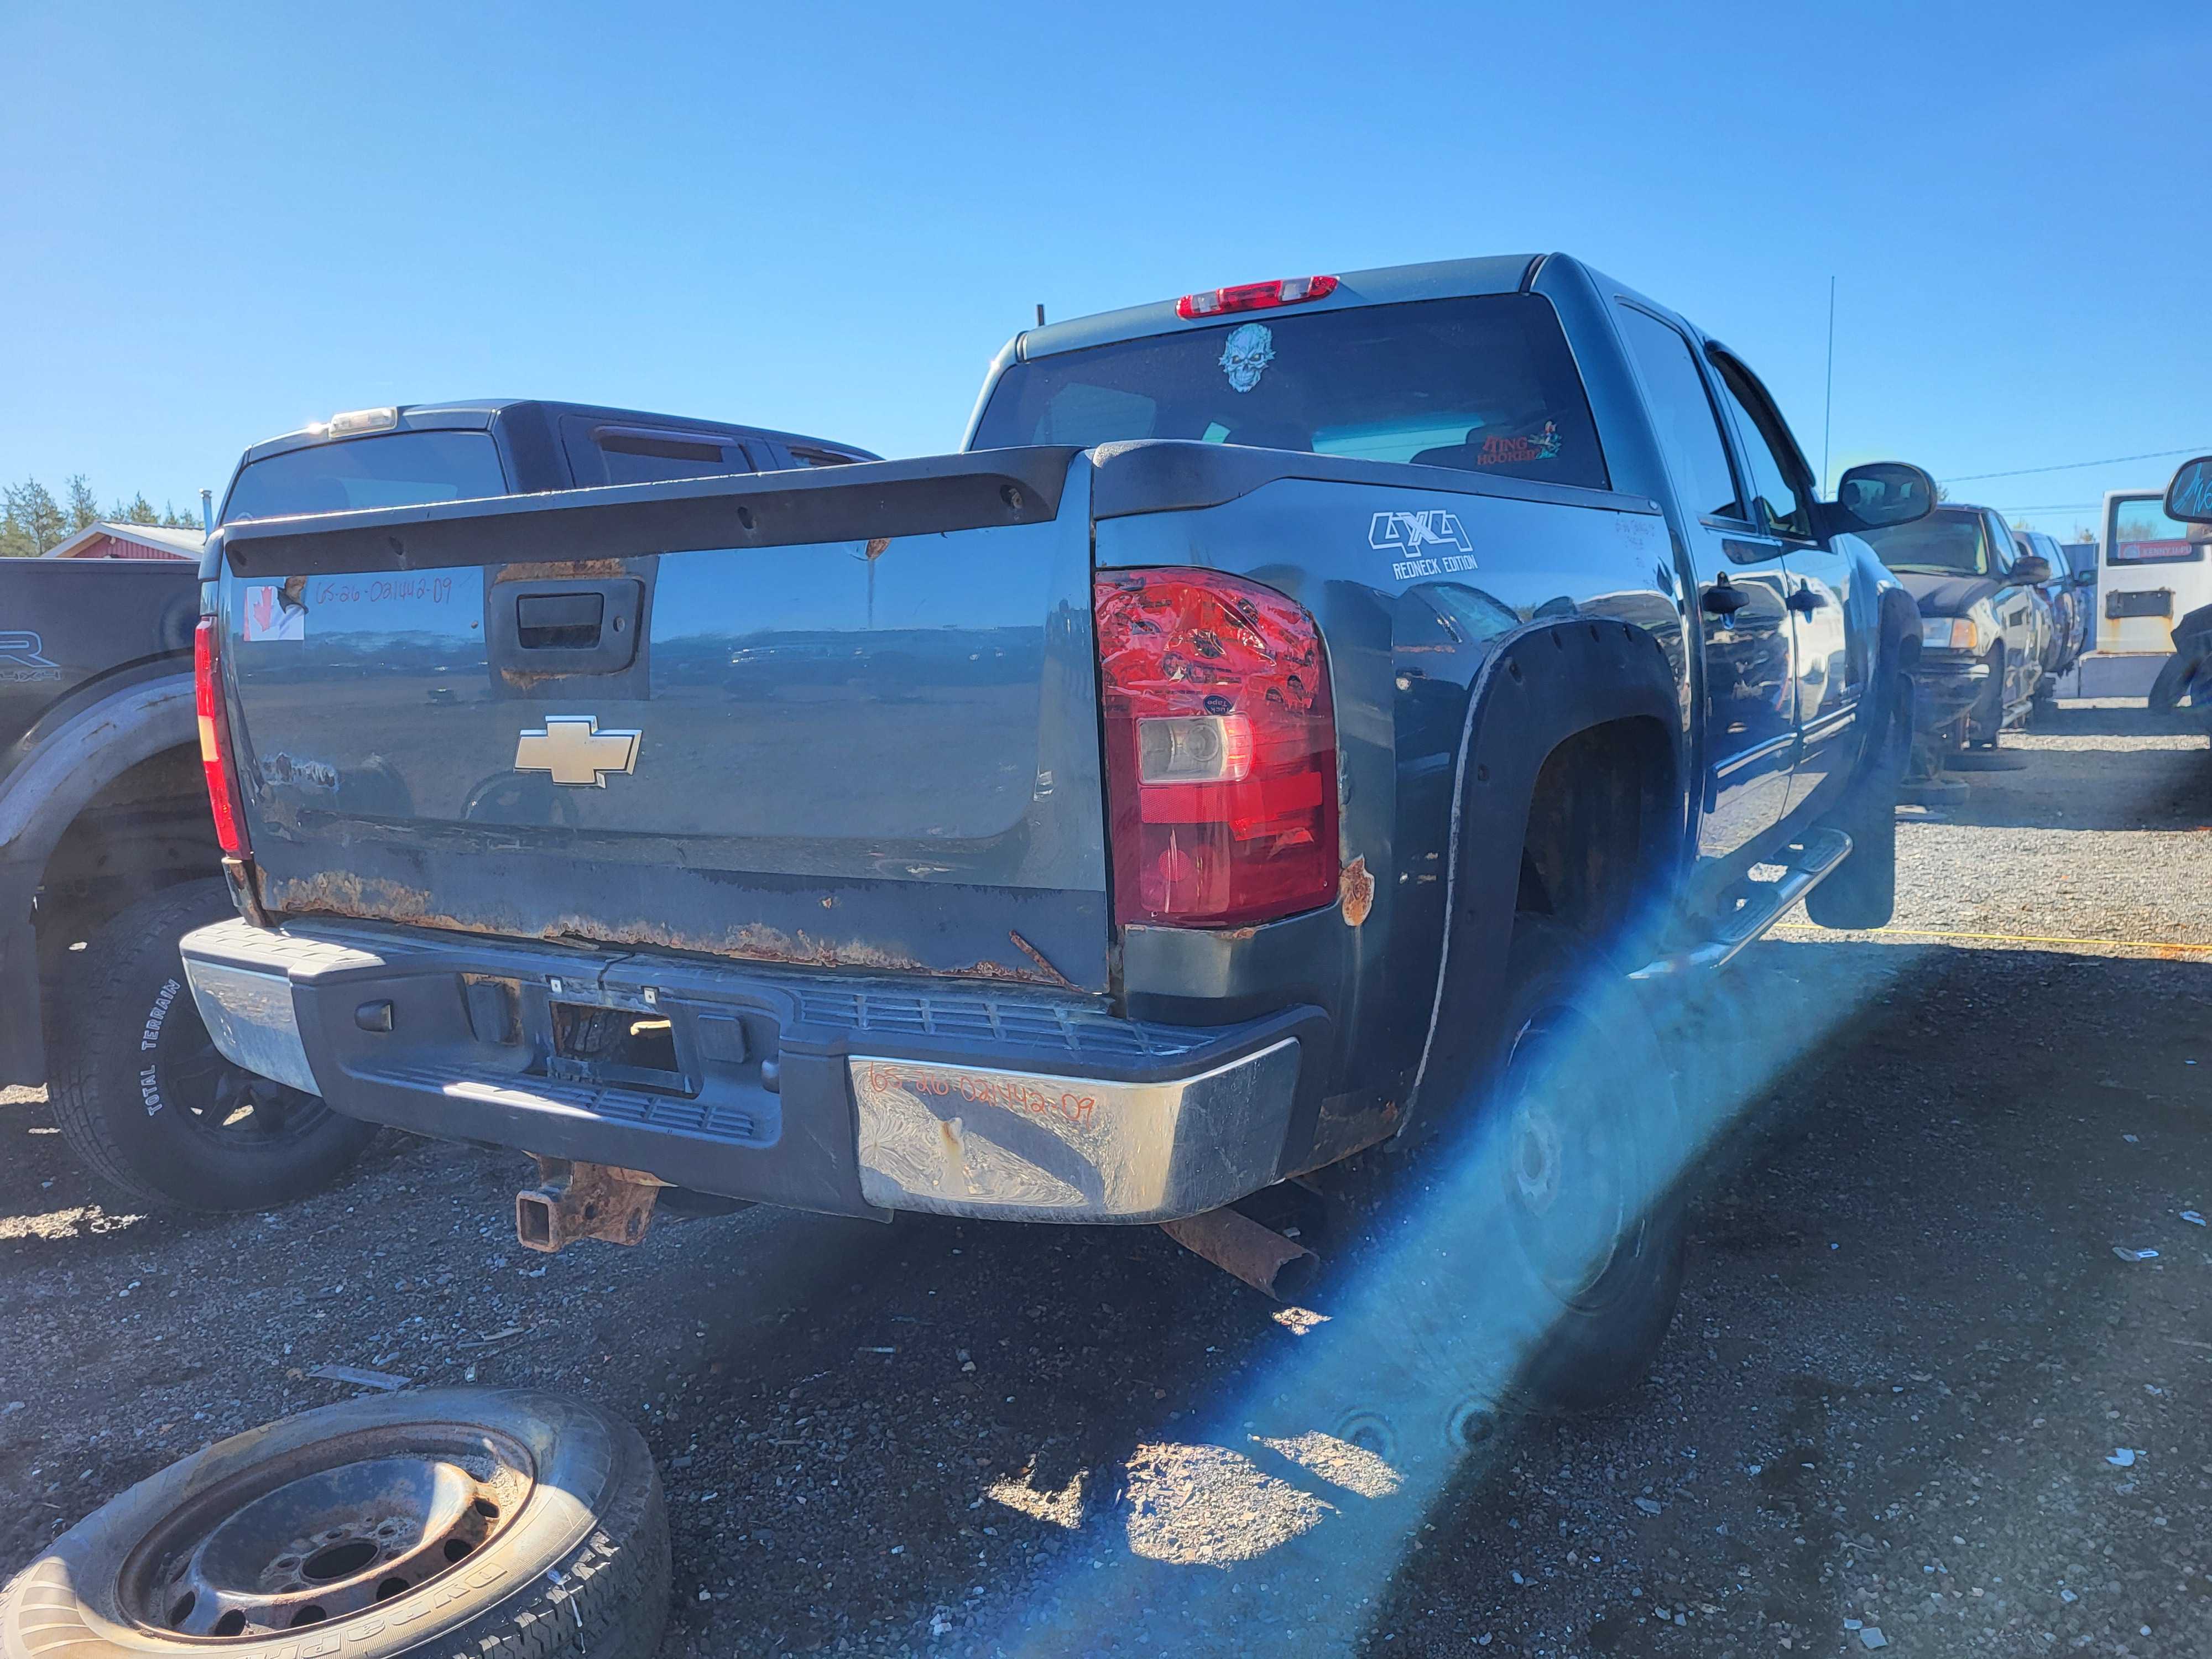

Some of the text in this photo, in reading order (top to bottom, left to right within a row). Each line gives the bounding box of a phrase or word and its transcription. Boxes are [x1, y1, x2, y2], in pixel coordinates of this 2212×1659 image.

[1392, 555, 1478, 580] REDNECK EDITION
[140, 978, 181, 1116] TOTAL TERRAIN
